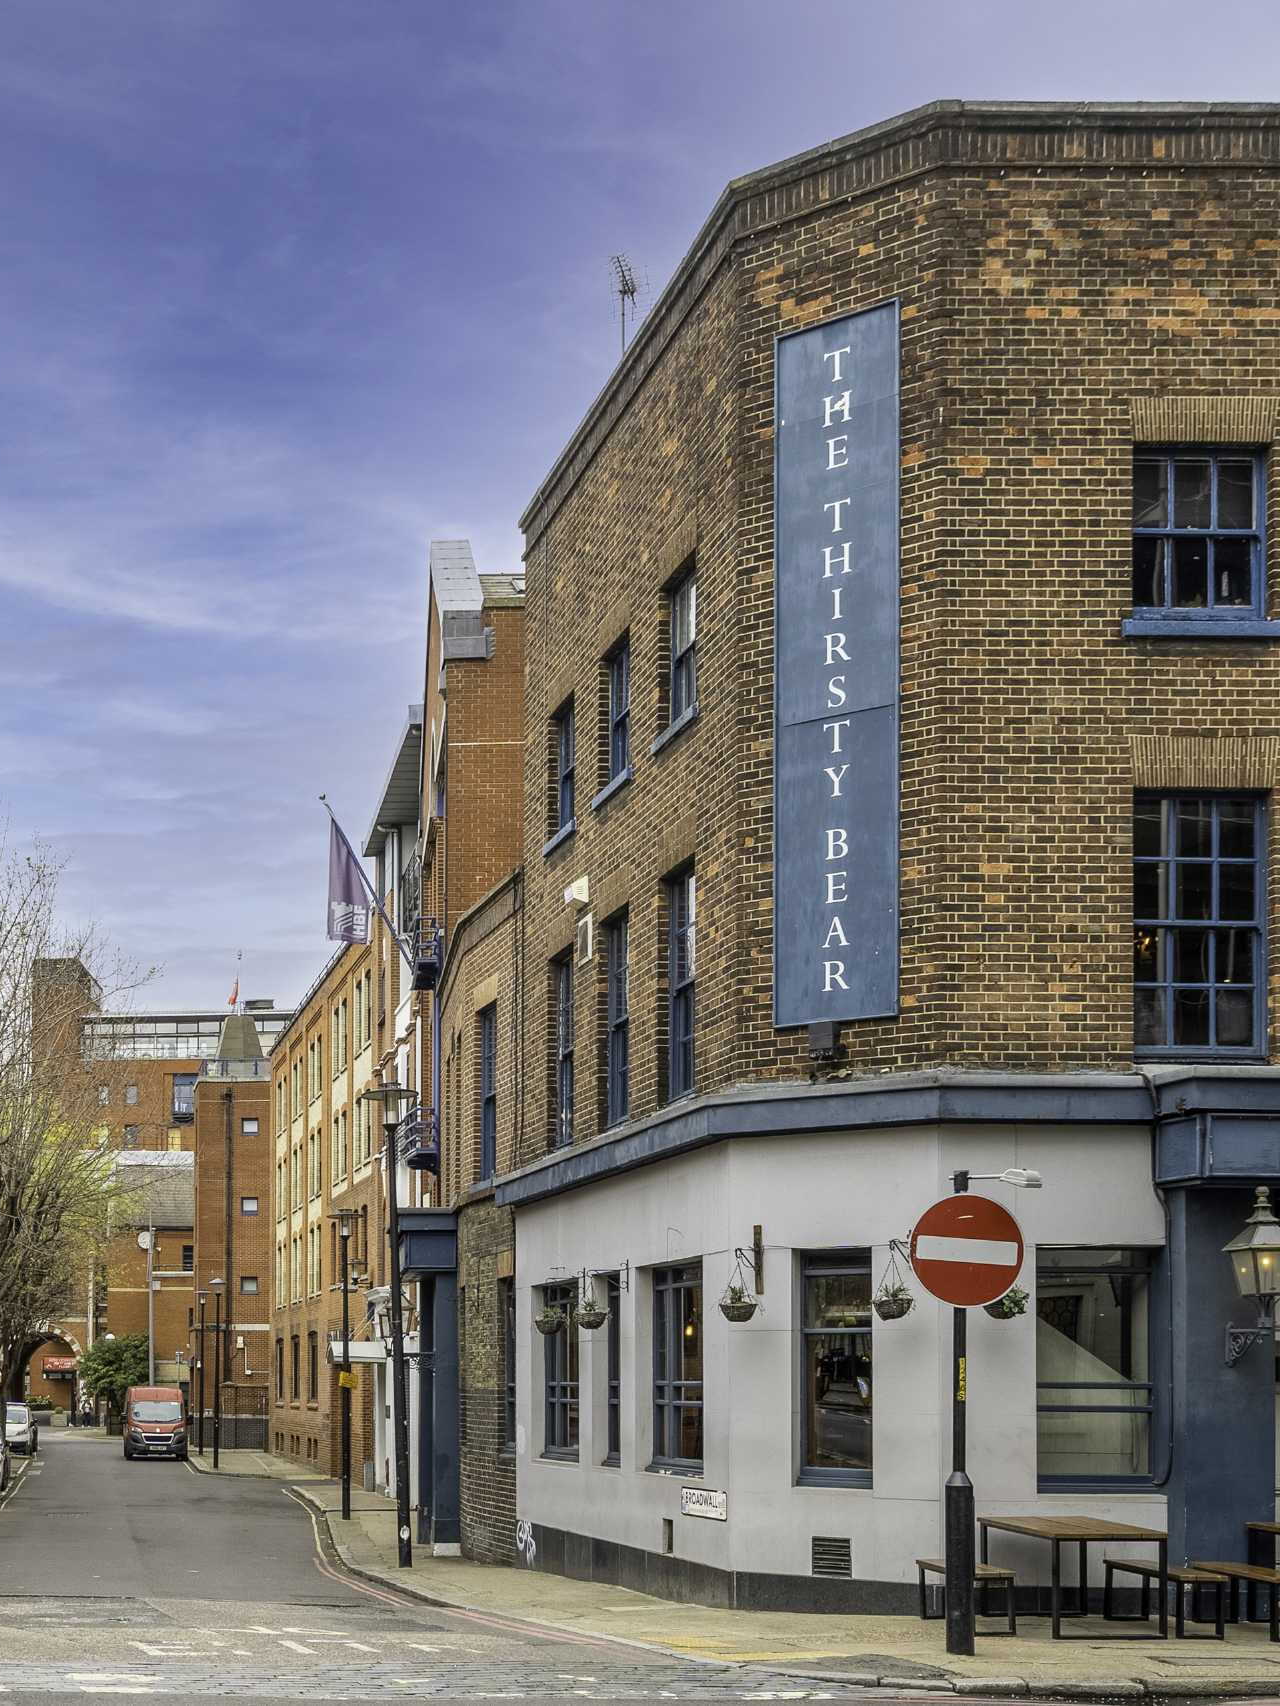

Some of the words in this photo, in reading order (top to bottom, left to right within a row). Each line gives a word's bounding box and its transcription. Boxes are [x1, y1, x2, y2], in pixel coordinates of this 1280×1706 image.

[821, 346, 852, 471] THE
[821, 498, 852, 798] THIRSTY
[821, 828, 850, 993] BEAR
[685, 1491, 718, 1509] BROADWALL
